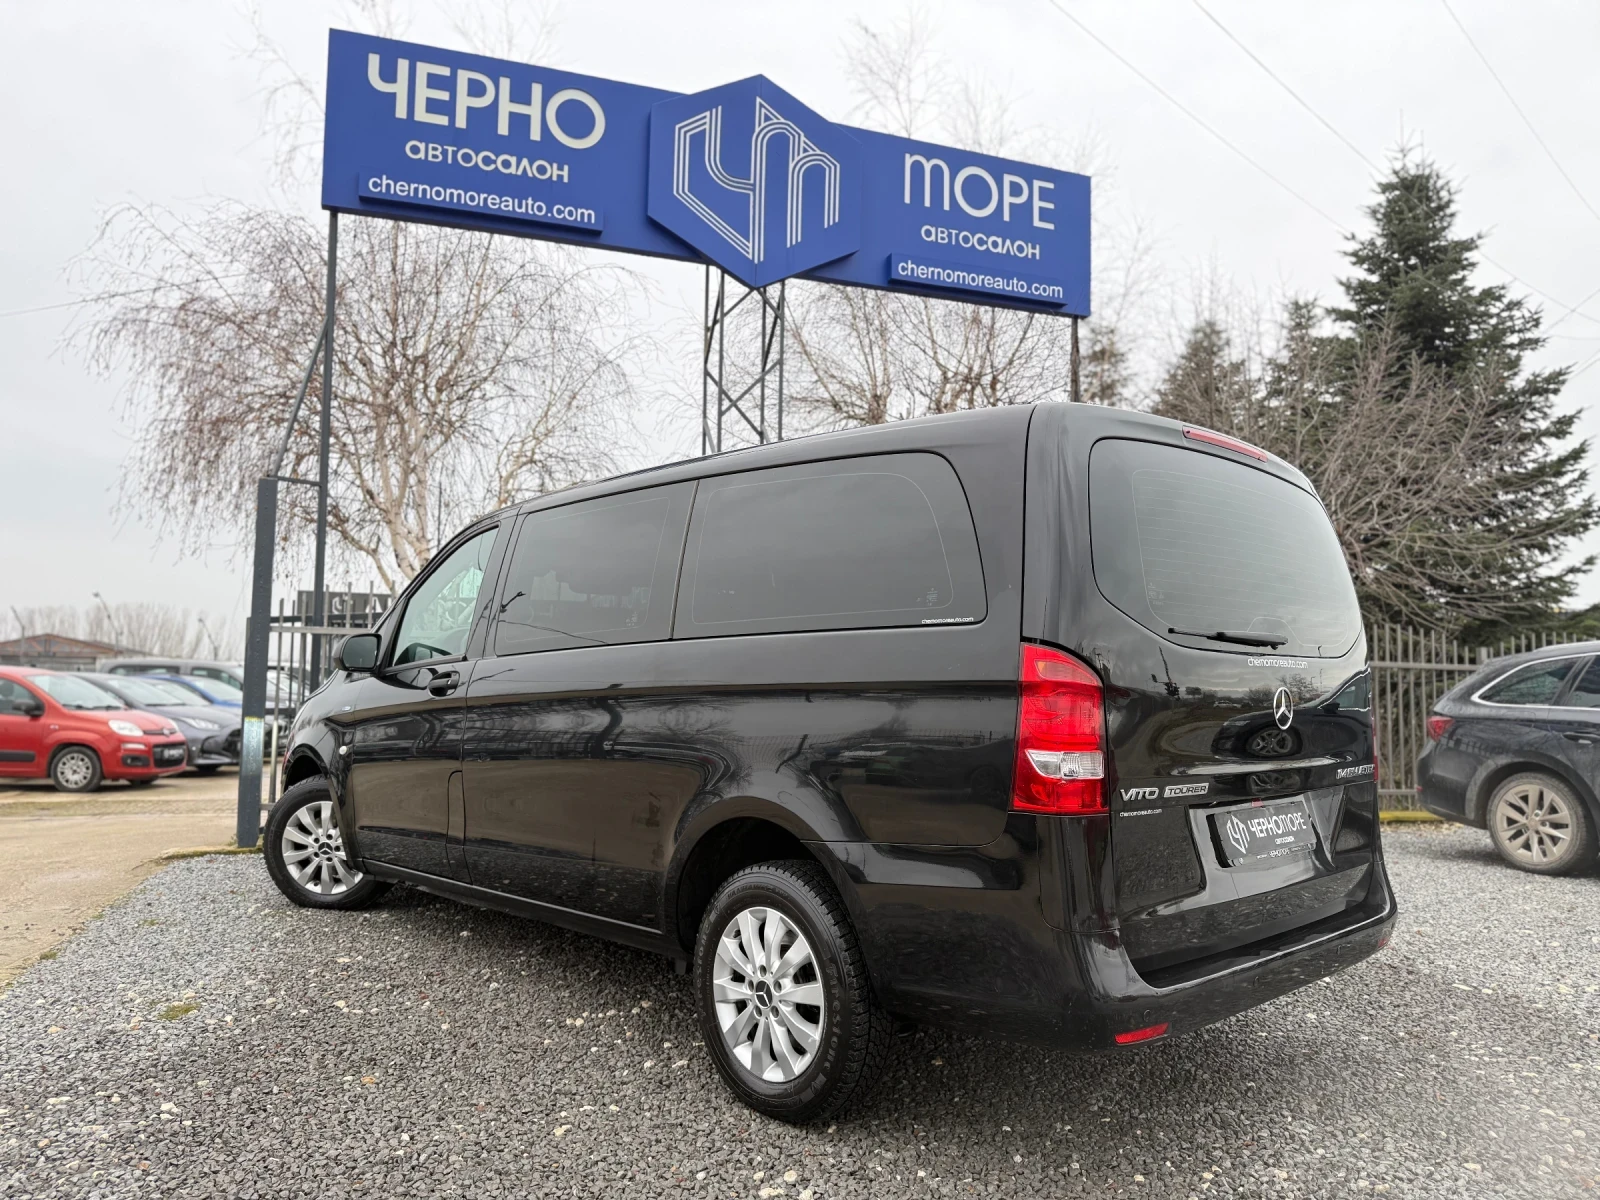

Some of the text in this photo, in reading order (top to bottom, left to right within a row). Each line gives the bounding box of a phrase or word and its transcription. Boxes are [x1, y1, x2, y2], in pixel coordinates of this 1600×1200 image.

[367, 52, 606, 149] ЧЕРНО
[368, 174, 596, 224] chernomoreauto.com
[897, 260, 1063, 298] chernomoreauto.com
[1120, 787, 1159, 801] VITO
[1166, 785, 1207, 796] TOURER
[1248, 812, 1307, 838] ЧЕРНОМОРЕ
[823, 962, 843, 1071] Firestone
